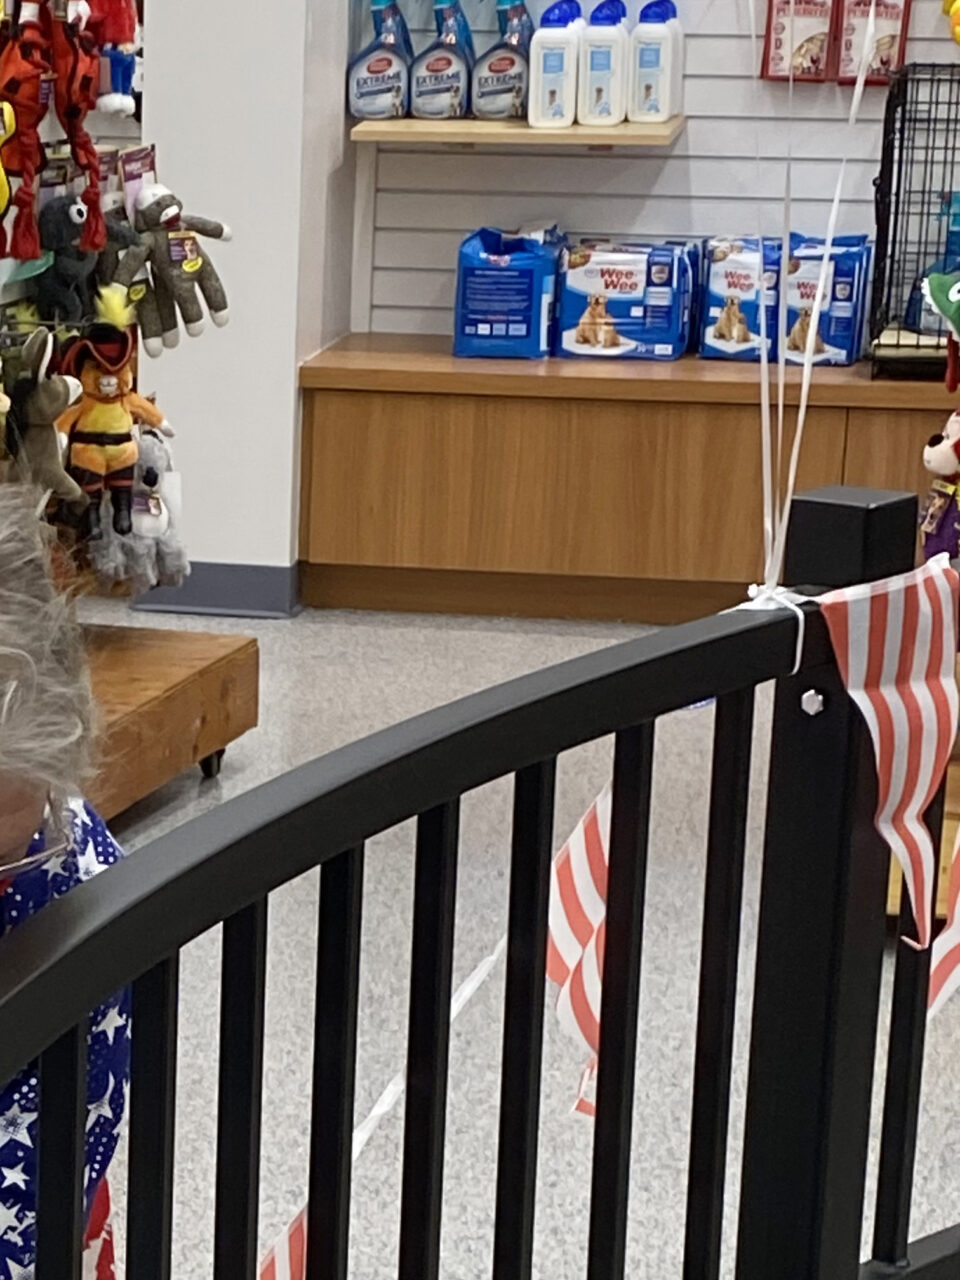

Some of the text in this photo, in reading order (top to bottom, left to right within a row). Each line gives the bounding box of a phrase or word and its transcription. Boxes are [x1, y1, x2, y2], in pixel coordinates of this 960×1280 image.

[355, 70, 402, 88] EXTREME
[416, 70, 461, 88] EXTREME
[478, 71, 523, 88] EXTREME
[604, 279, 639, 291] Wee
